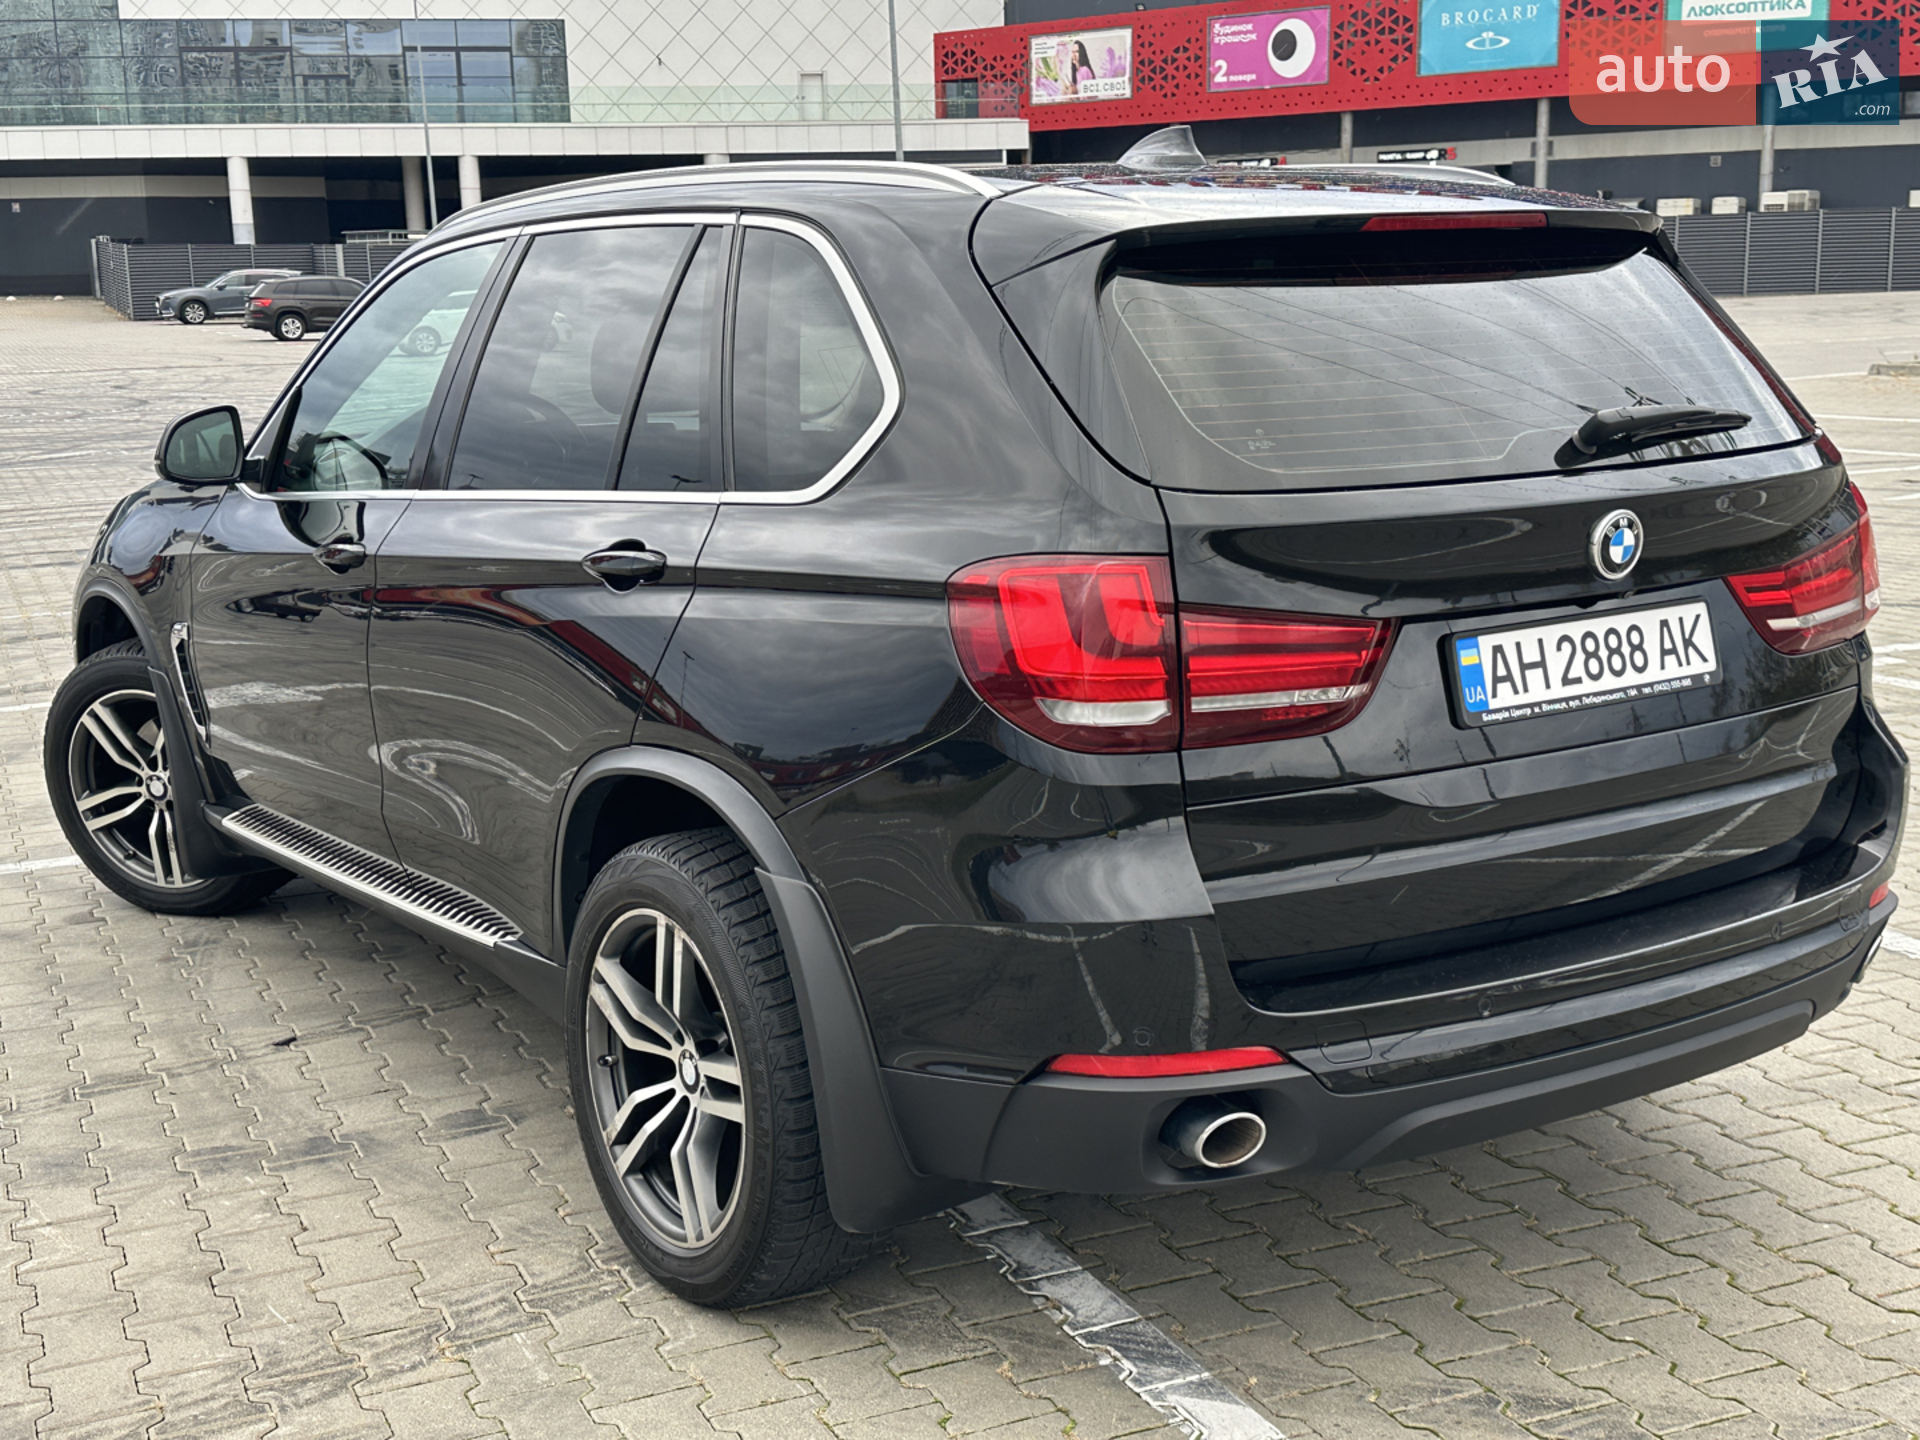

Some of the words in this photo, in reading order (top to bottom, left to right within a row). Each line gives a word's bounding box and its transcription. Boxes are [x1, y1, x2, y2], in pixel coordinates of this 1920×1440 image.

[1441, 4, 1538, 27] BROCARD
[1213, 59, 1228, 83] 2
[1490, 638, 1551, 699] AH
[1556, 624, 1649, 687] 2888
[1659, 613, 1709, 670] AK
[1465, 685, 1486, 703] UA
